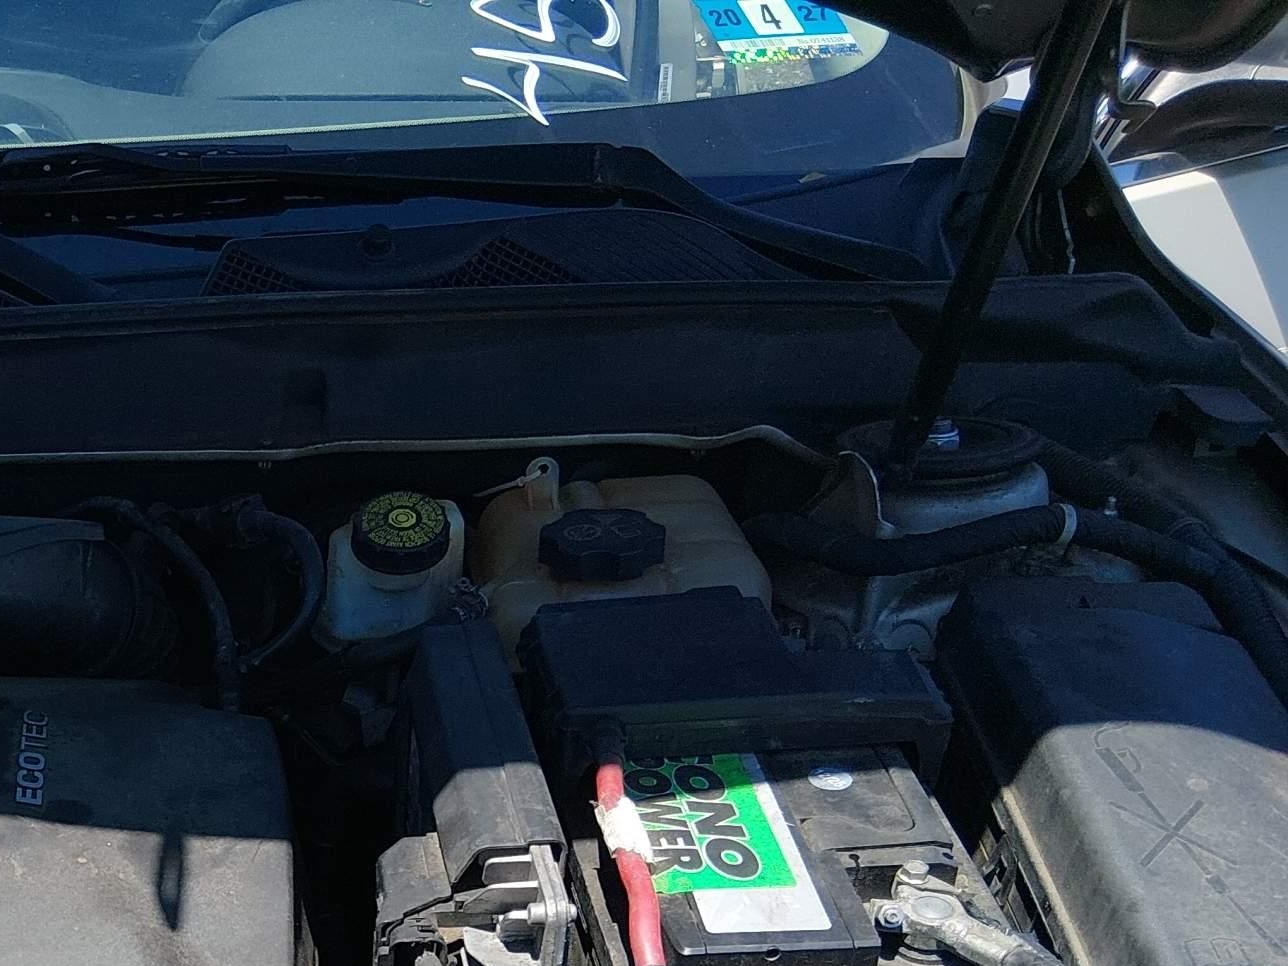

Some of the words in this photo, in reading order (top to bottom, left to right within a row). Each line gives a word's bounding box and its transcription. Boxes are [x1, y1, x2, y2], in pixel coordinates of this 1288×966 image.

[708, 8, 743, 27] 20
[760, 4, 782, 30] 4
[797, 5, 828, 22] 27
[15, 710, 49, 806] ECOTEC
